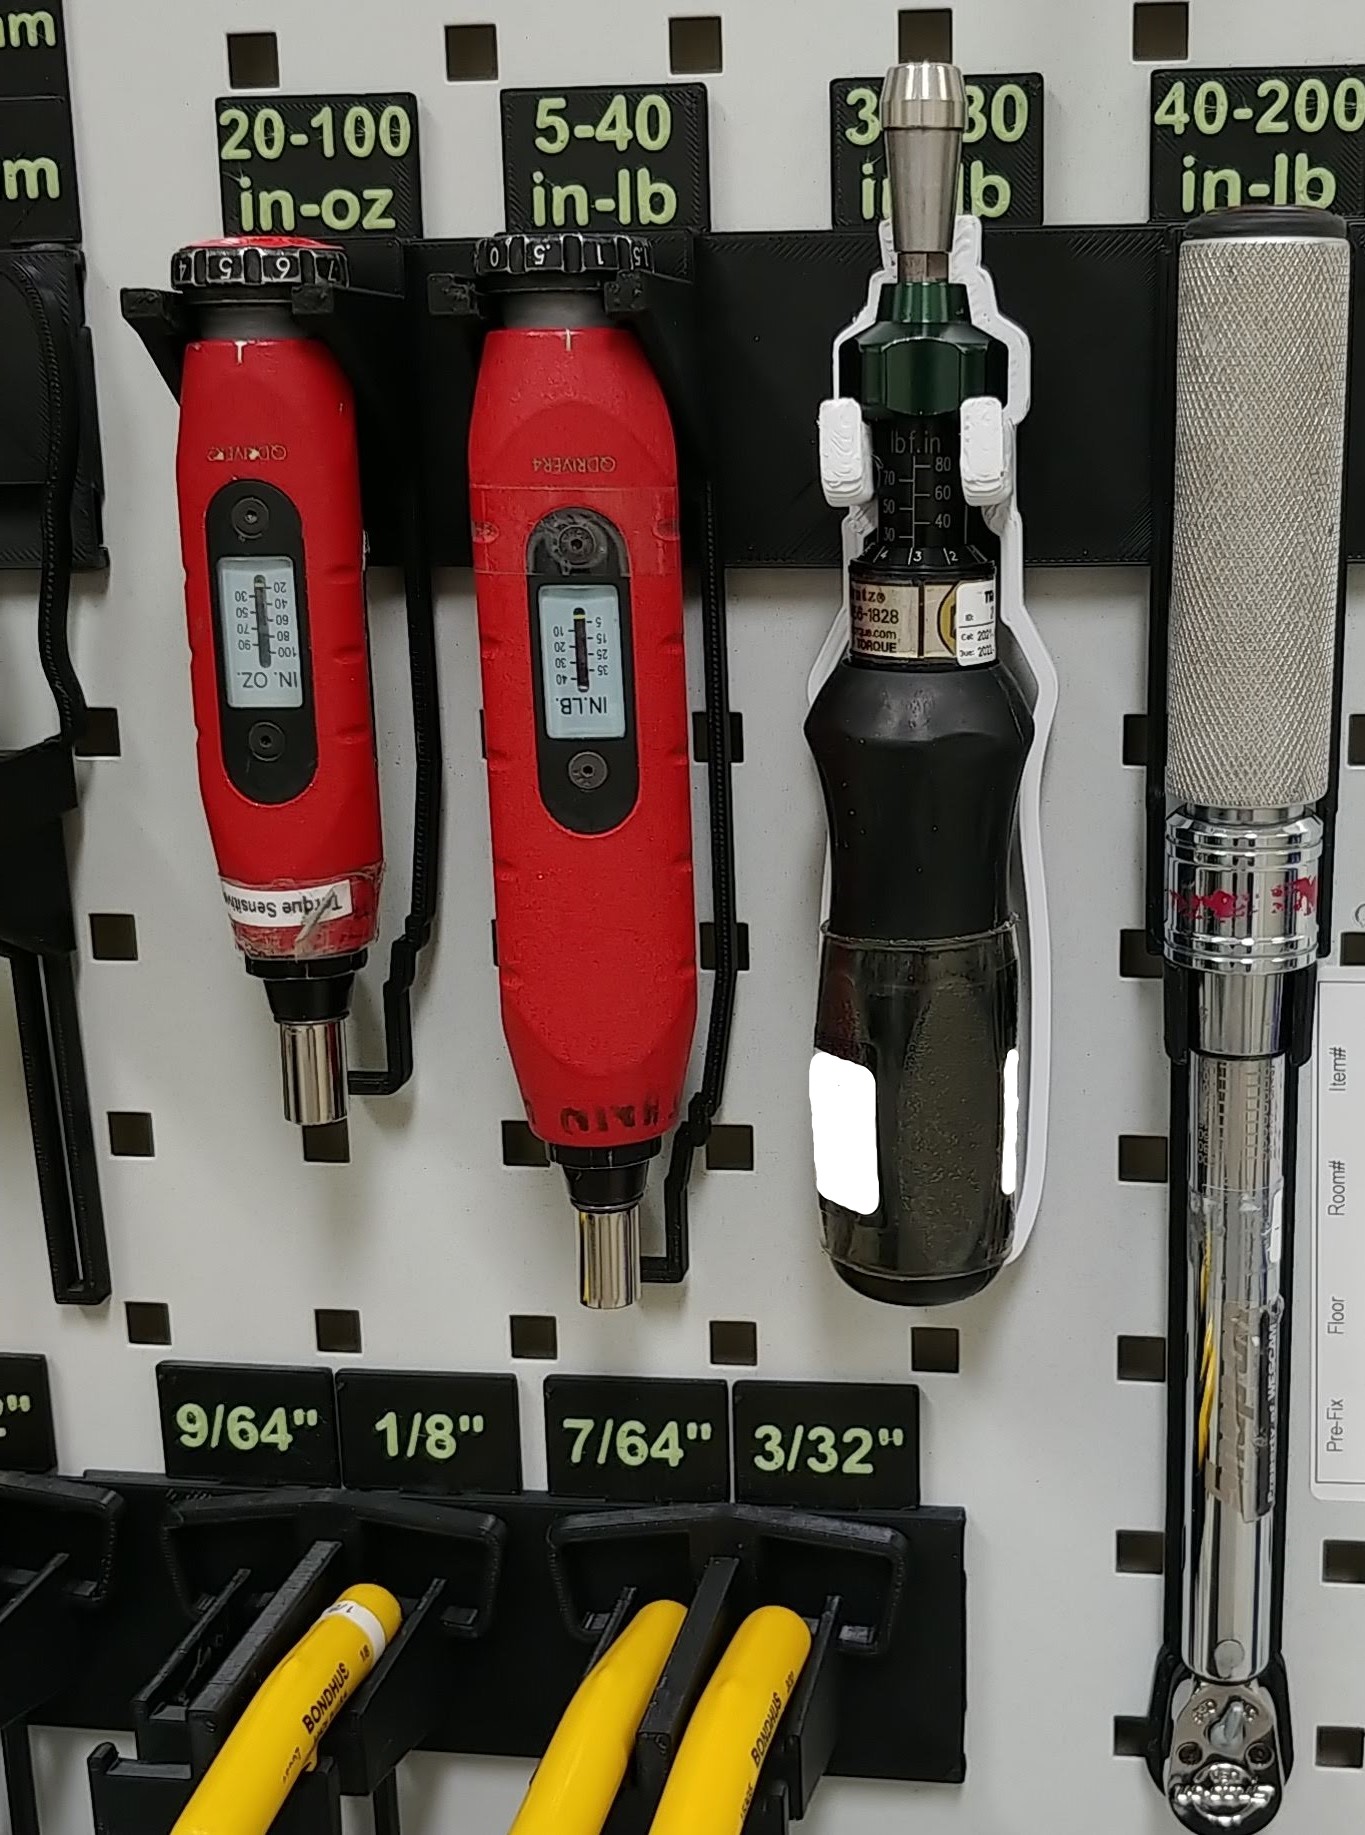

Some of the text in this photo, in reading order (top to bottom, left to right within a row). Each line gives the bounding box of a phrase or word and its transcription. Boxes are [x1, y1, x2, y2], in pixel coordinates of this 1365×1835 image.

[1154, 77, 1365, 135] 40-200
[534, 94, 672, 154] 5-40
[218, 105, 412, 160] 20-100
[1181, 152, 1337, 216] in-lb
[238, 175, 397, 232] in-oz
[532, 167, 678, 228] in-lb
[218, 256, 233, 281] 5
[531, 455, 617, 474] QDRIVER4
[934, 456, 952, 472] 80
[882, 470, 896, 486] 70
[934, 485, 952, 501] 60
[882, 499, 896, 515] 50
[934, 513, 951, 529] 40
[273, 581, 287, 593] 20
[234, 590, 248, 602] 30
[274, 598, 288, 610] 40
[235, 607, 249, 618] 50
[275, 614, 289, 626] 60
[236, 623, 250, 634] 70
[595, 616, 602, 628] 5
[276, 630, 290, 642] 80
[553, 625, 564, 637] 10
[596, 633, 607, 644] 15
[237, 639, 251, 651] 90
[277, 646, 298, 658] 100
[554, 641, 566, 653] 20
[856, 638, 897, 653] TORQUE
[597, 648, 608, 660] 25
[555, 657, 567, 669] 30
[598, 664, 609, 676] 35
[556, 673, 568, 686] 40
[1328, 1046, 1346, 1092] Item#
[1327, 1160, 1346, 1217] Room#
[1327, 1295, 1345, 1335] Floor
[176, 1402, 319, 1452] 9/64"
[1326, 1398, 1344, 1452] Pre-Fix
[374, 1411, 484, 1460] 1/8"
[562, 1417, 713, 1467] 7/64"
[753, 1424, 904, 1474] 3/32"
[301, 1661, 351, 1735] BONDHUS
[750, 1691, 783, 1770] BONDHUS
